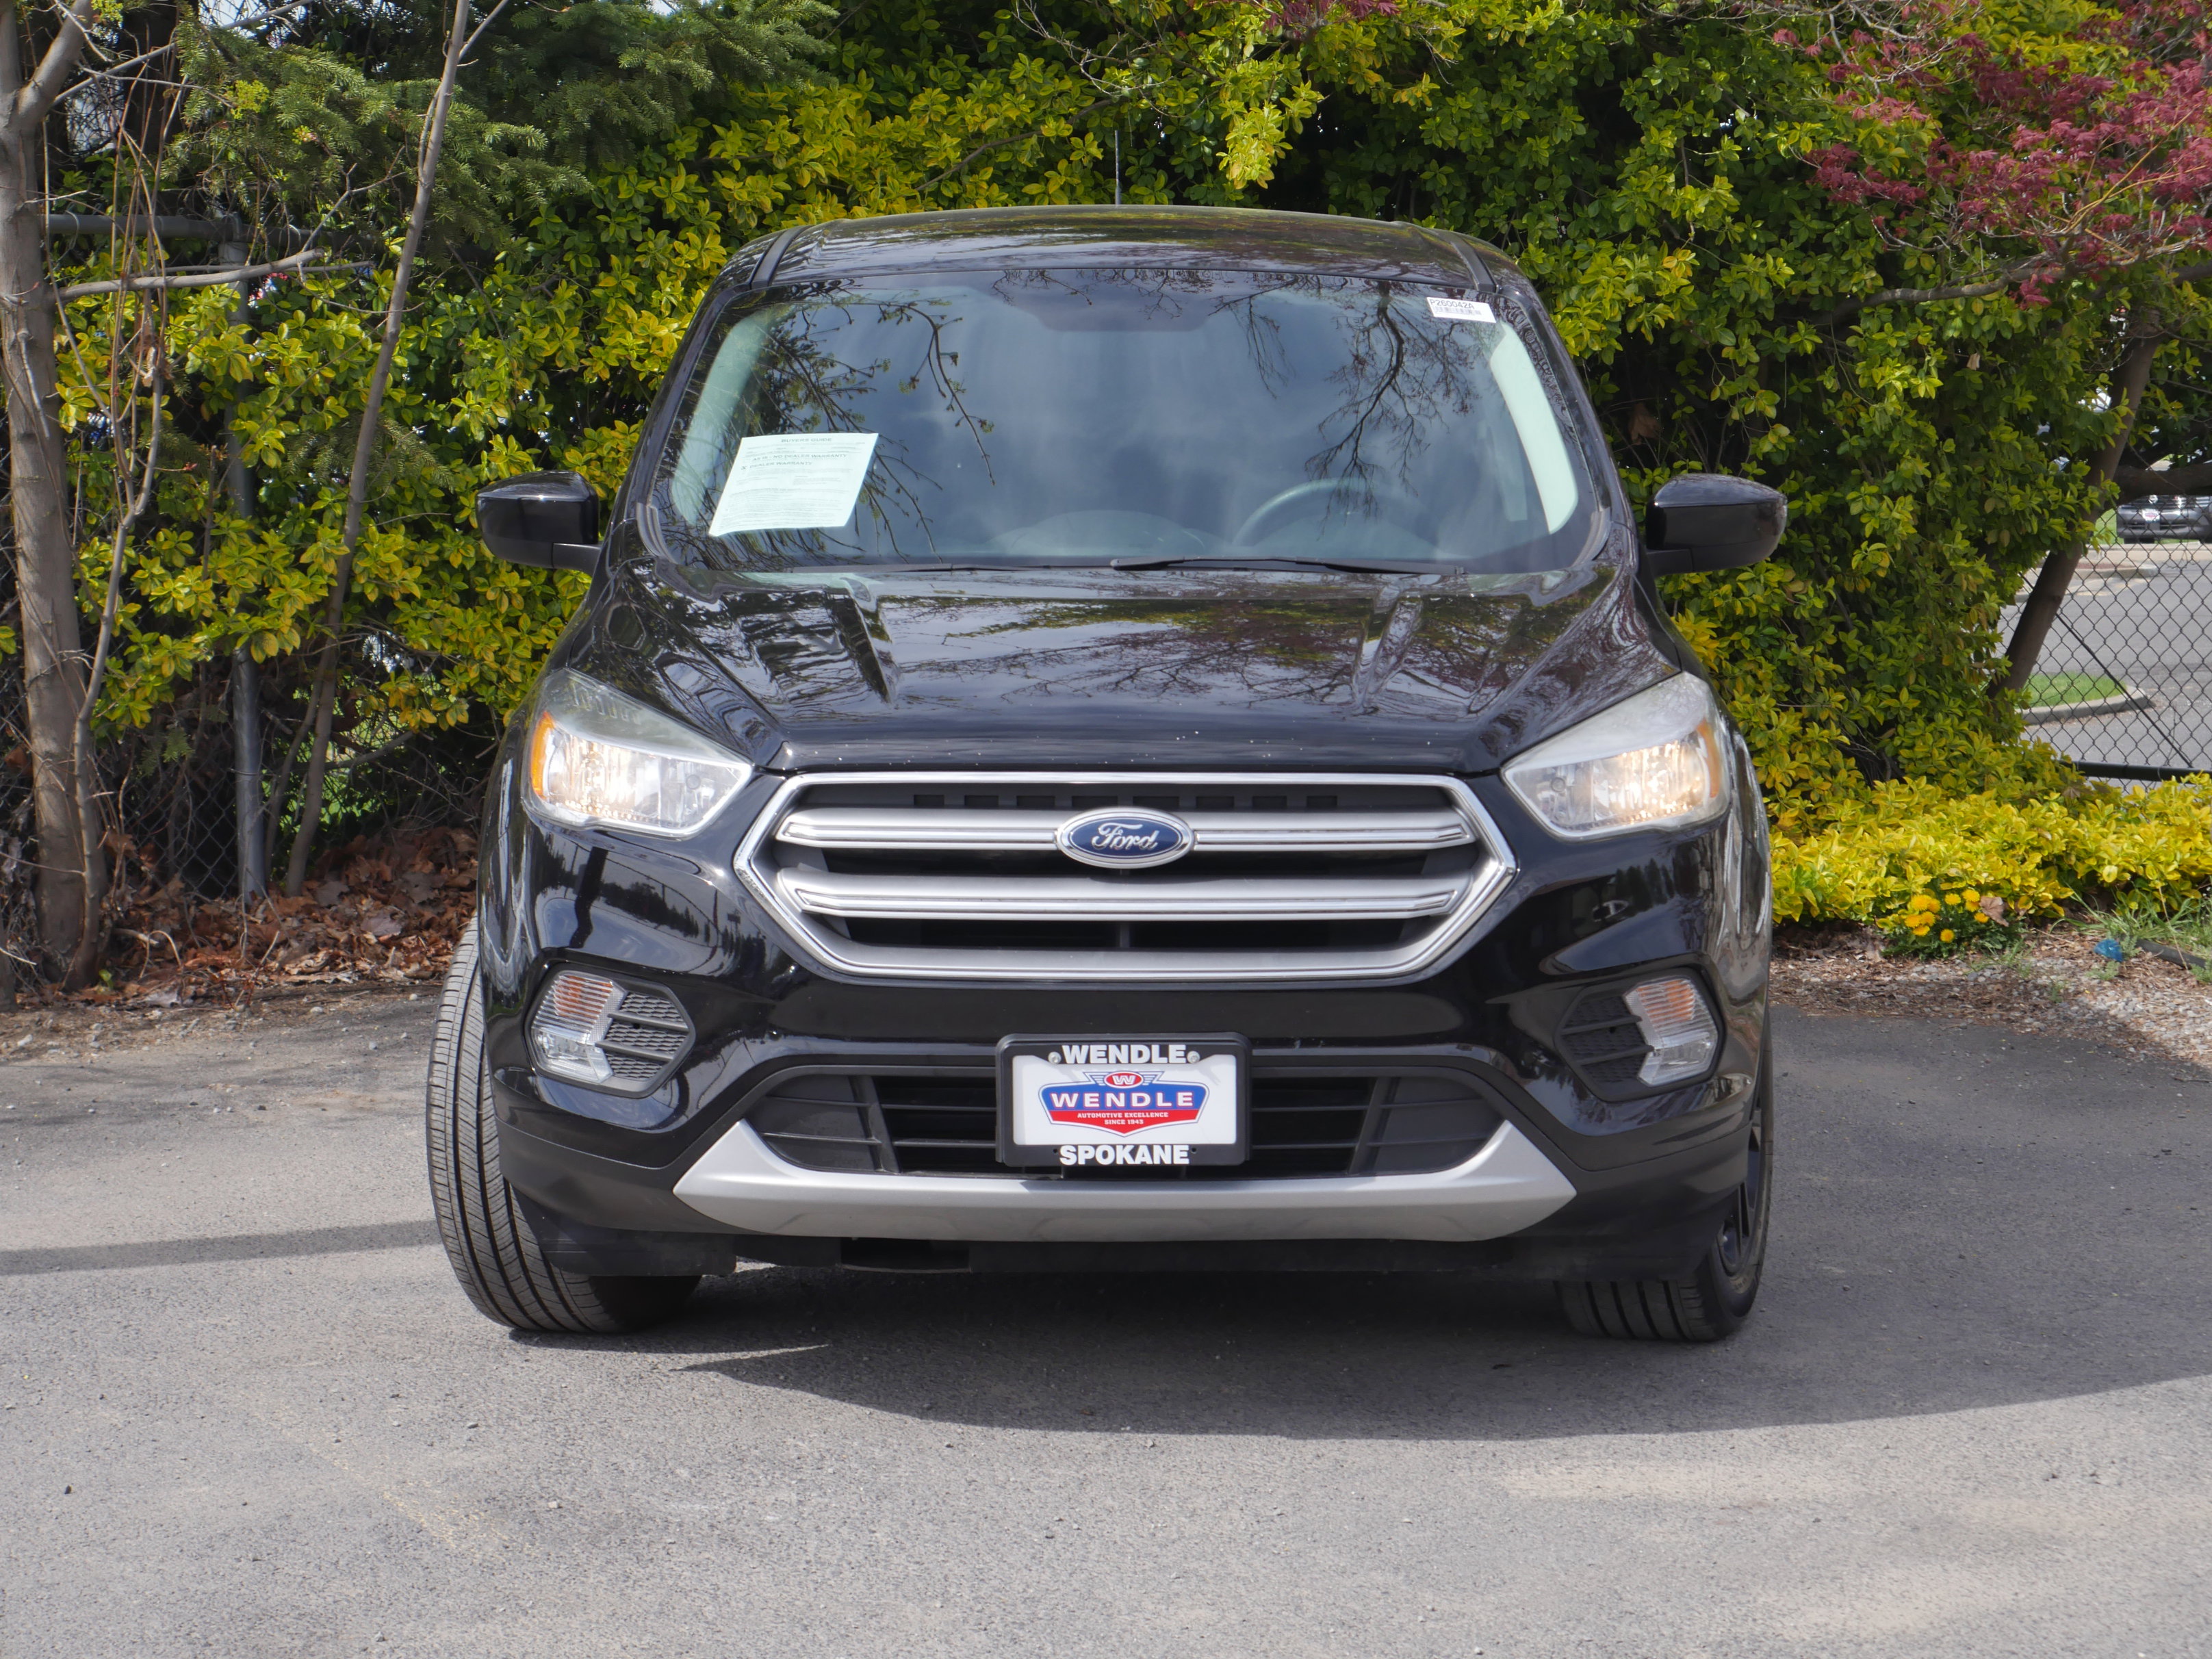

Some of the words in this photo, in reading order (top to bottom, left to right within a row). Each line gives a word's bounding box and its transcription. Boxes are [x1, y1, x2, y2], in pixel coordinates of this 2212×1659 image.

[1429, 299, 1475, 309] P260042A
[1092, 822, 1160, 850] Ford
[1062, 1044, 1187, 1064] WENDLE
[1051, 1092, 1194, 1107] WENDLE
[1059, 1145, 1189, 1165] SPOKANE
